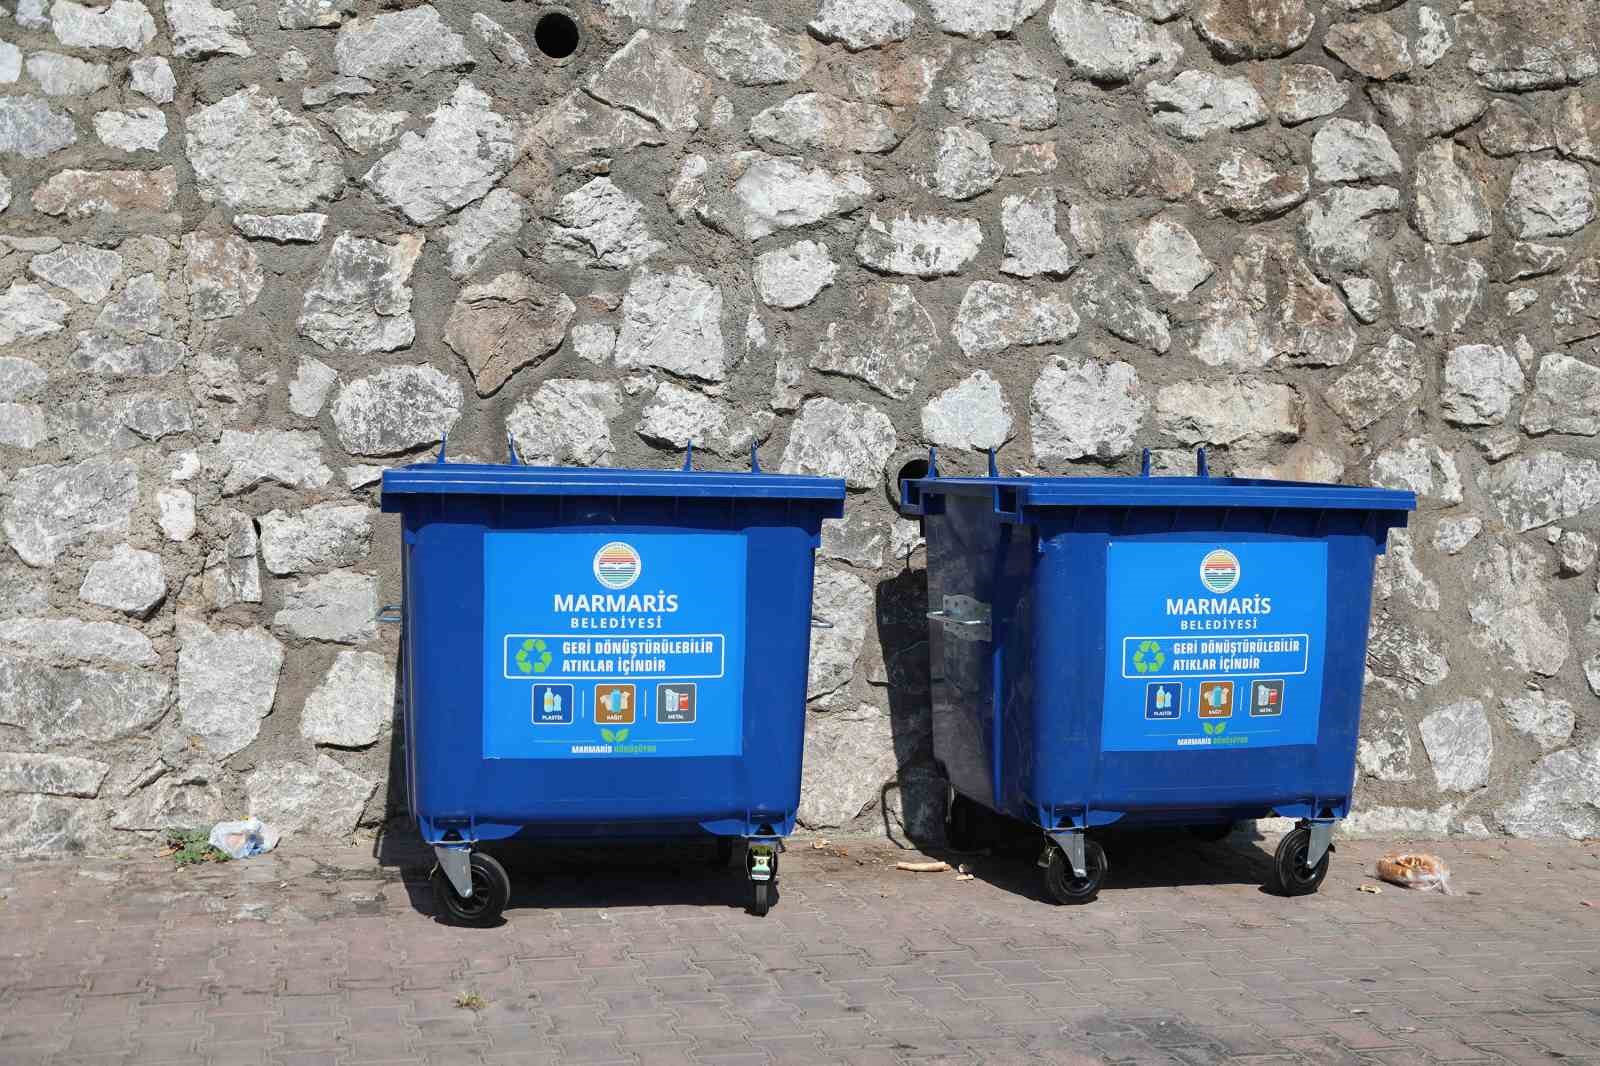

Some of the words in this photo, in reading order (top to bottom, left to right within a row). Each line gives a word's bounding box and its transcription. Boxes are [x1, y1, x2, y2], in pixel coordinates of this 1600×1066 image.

[554, 590, 678, 612] MARMARİS
[1167, 594, 1271, 615] MARMARİS
[571, 616, 663, 628] BELEDİYESİ
[1181, 617, 1257, 630] BELEDİYESİ
[562, 638, 591, 654] GERİ
[595, 638, 713, 659] DÖNÜŞTÜRÜLEBİLİR
[1174, 641, 1197, 655] GERİ
[1201, 639, 1299, 657] DÖNÜŞTÜRÜLEBİLİR
[562, 659, 613, 672] ATIKLAR
[618, 656, 666, 675] İÇİNDİR
[1173, 658, 1216, 671] ATIKLAR
[1220, 657, 1260, 673] İÇİNDİR
